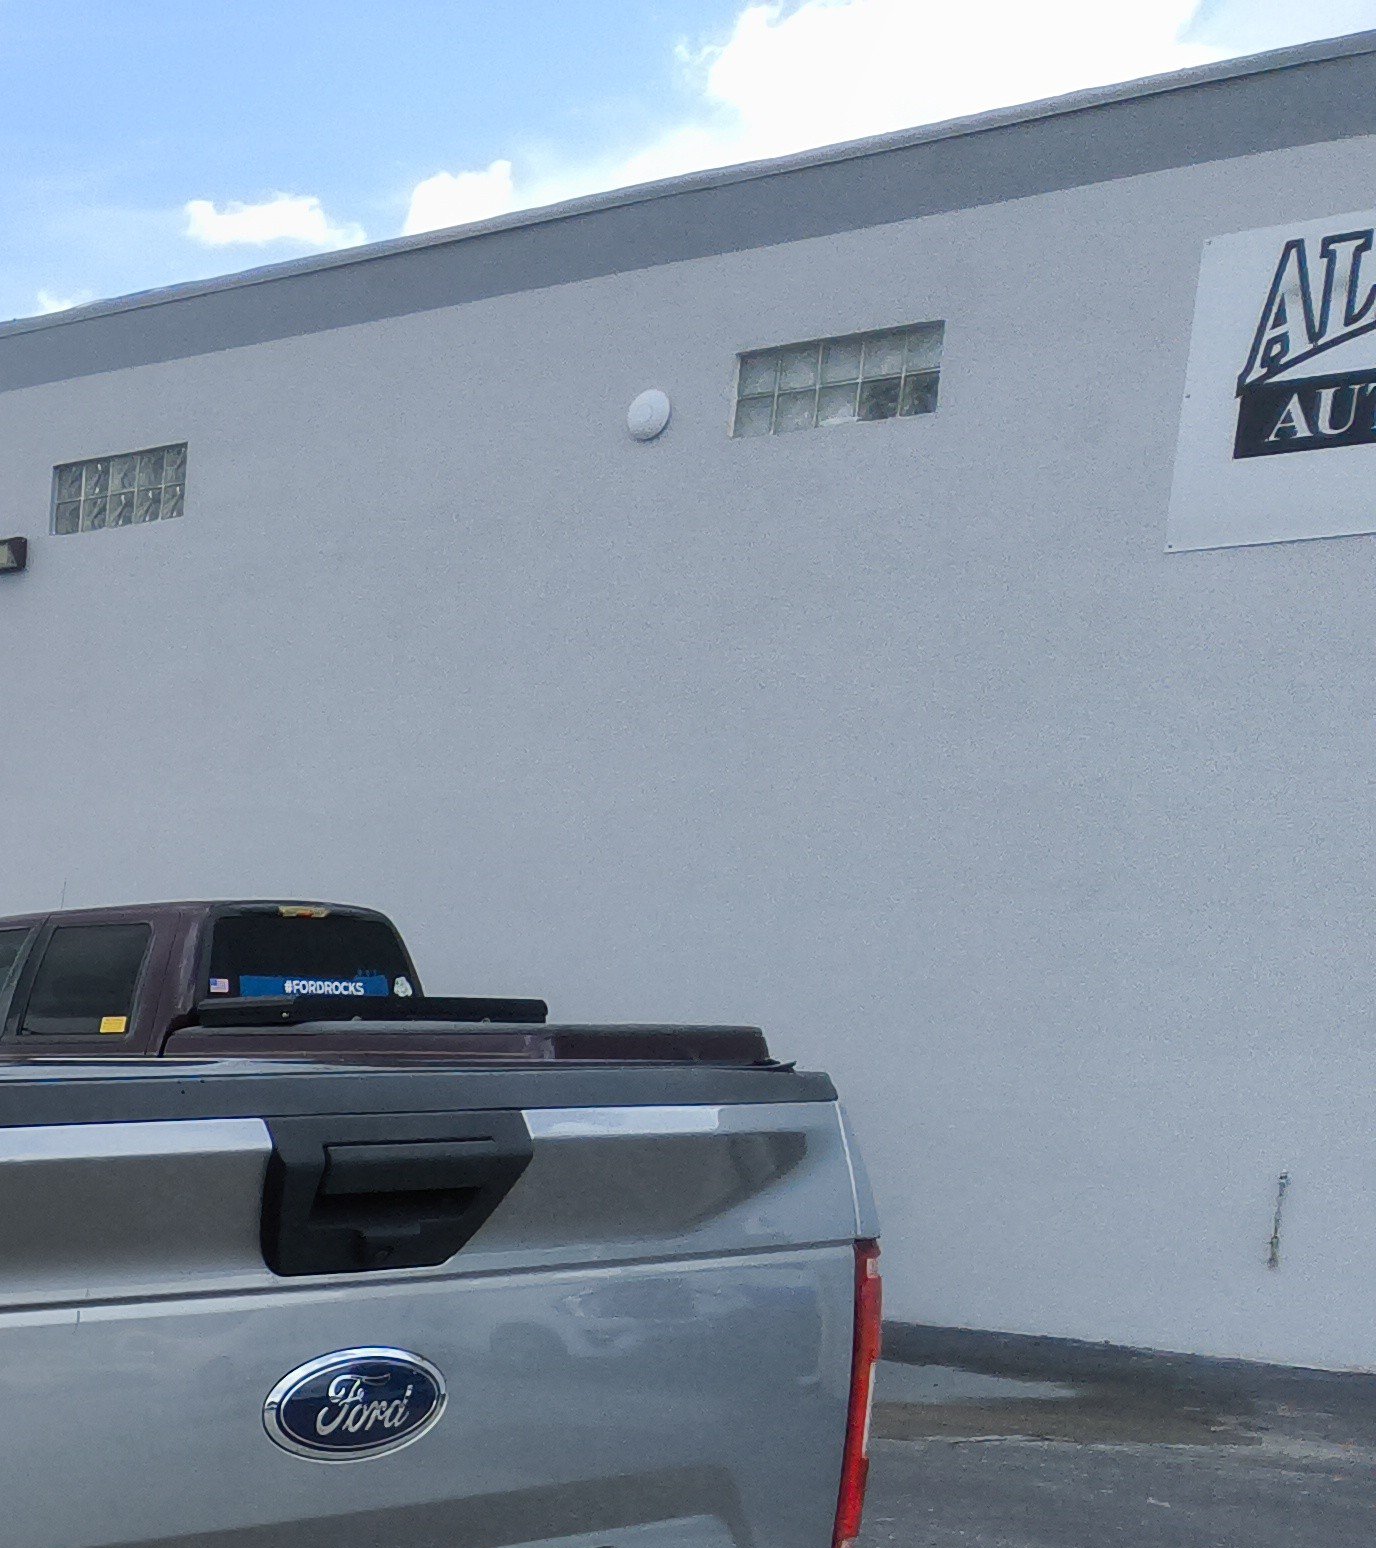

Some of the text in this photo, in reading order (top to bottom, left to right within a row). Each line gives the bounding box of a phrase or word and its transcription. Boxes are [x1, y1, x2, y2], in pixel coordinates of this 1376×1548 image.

[1264, 383, 1376, 441] AU
[284, 980, 364, 996] #FORDROCKS
[316, 1372, 414, 1437] Ford
